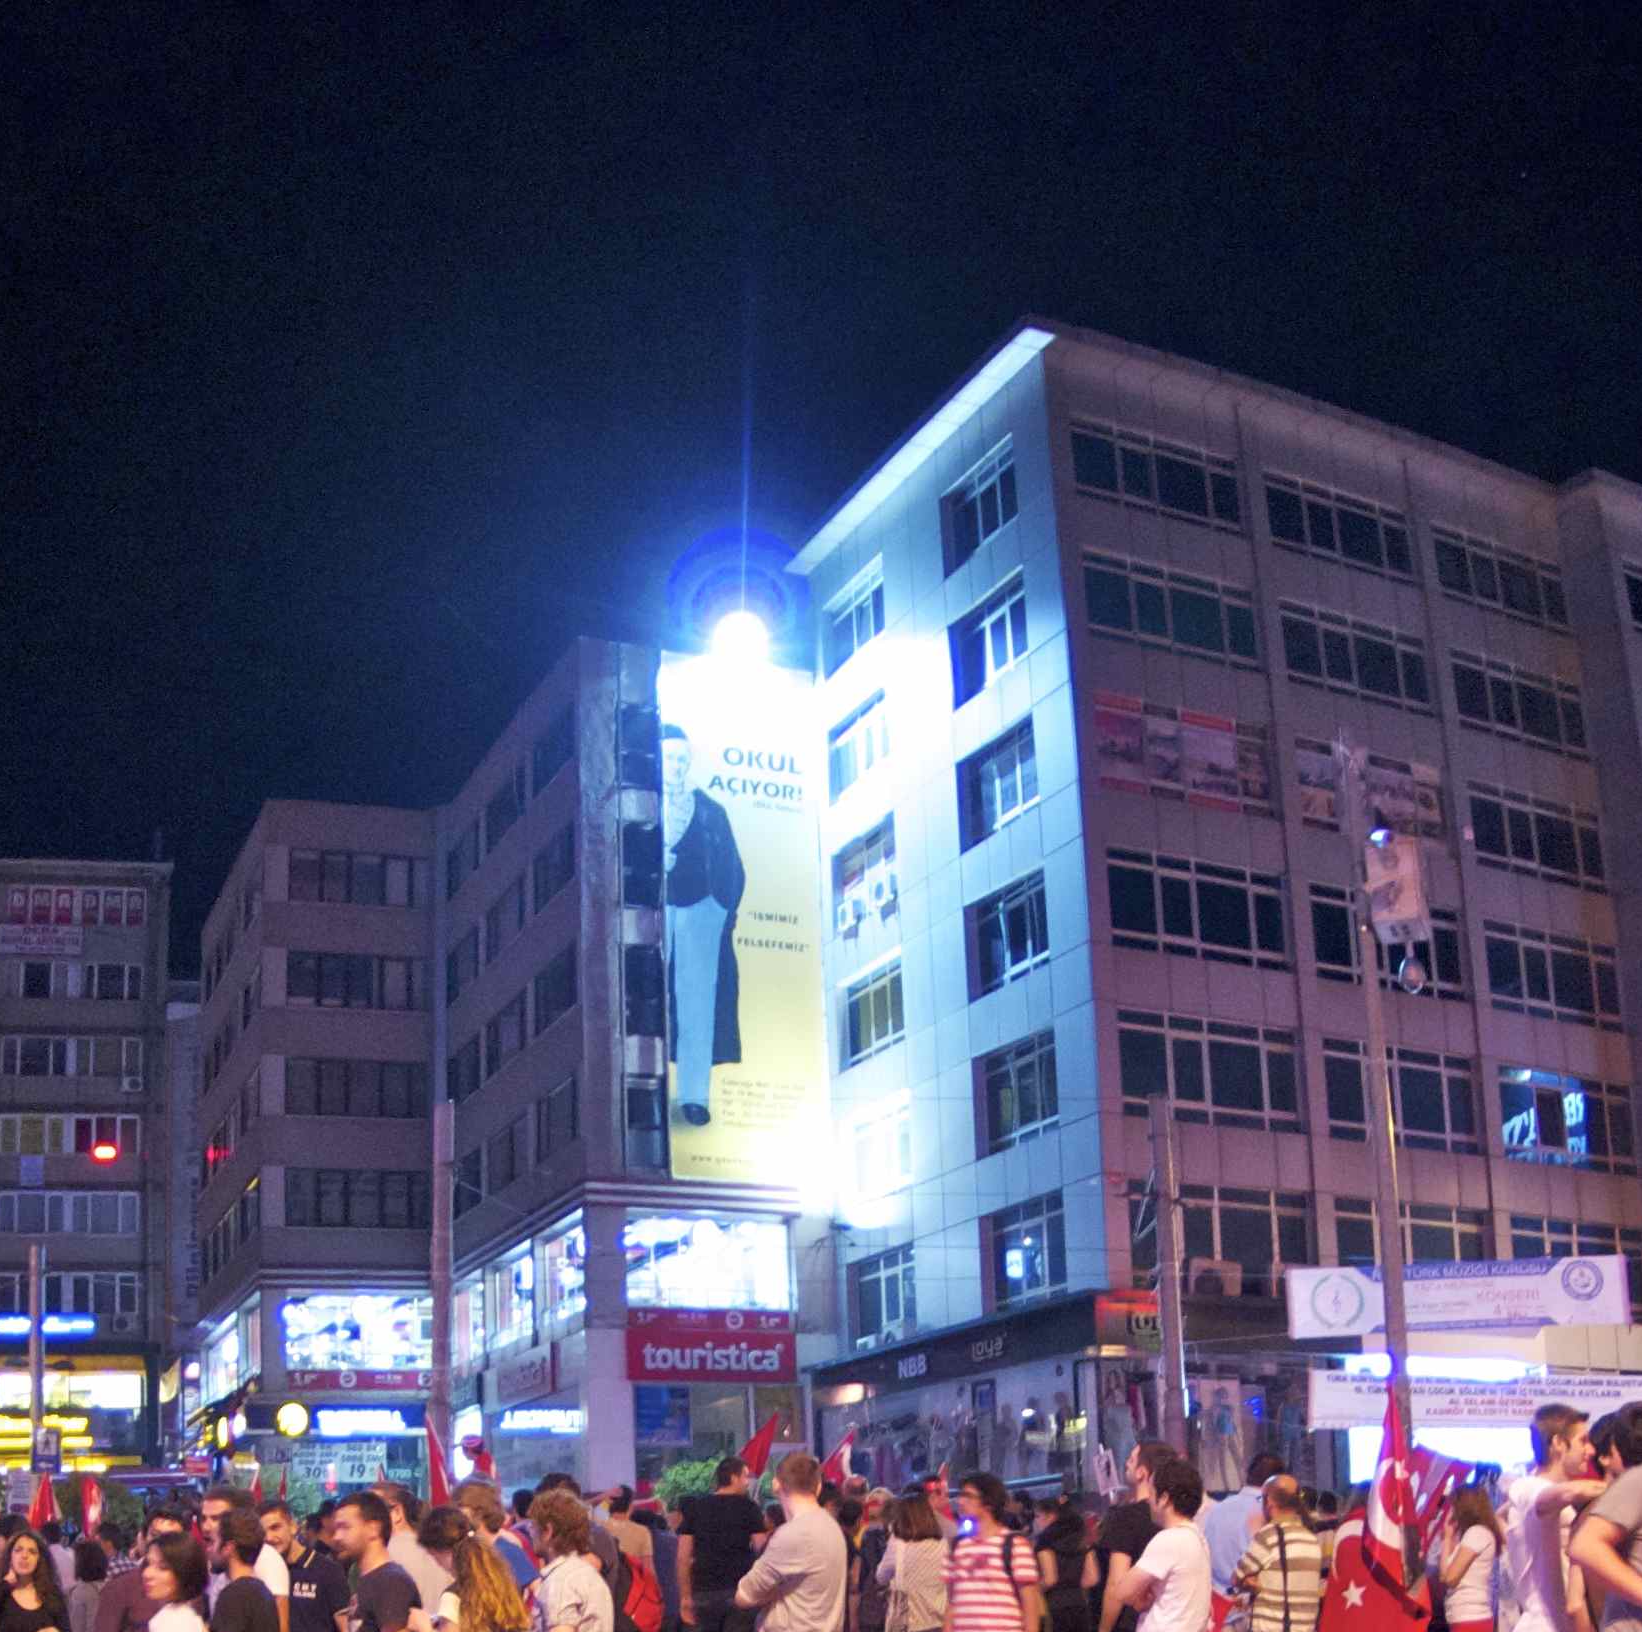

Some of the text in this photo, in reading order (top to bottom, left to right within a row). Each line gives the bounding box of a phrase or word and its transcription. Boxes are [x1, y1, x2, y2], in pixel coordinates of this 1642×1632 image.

[723, 747, 803, 775] OKUL
[642, 1341, 781, 1371] touristica
[898, 1354, 928, 1379] NBB
